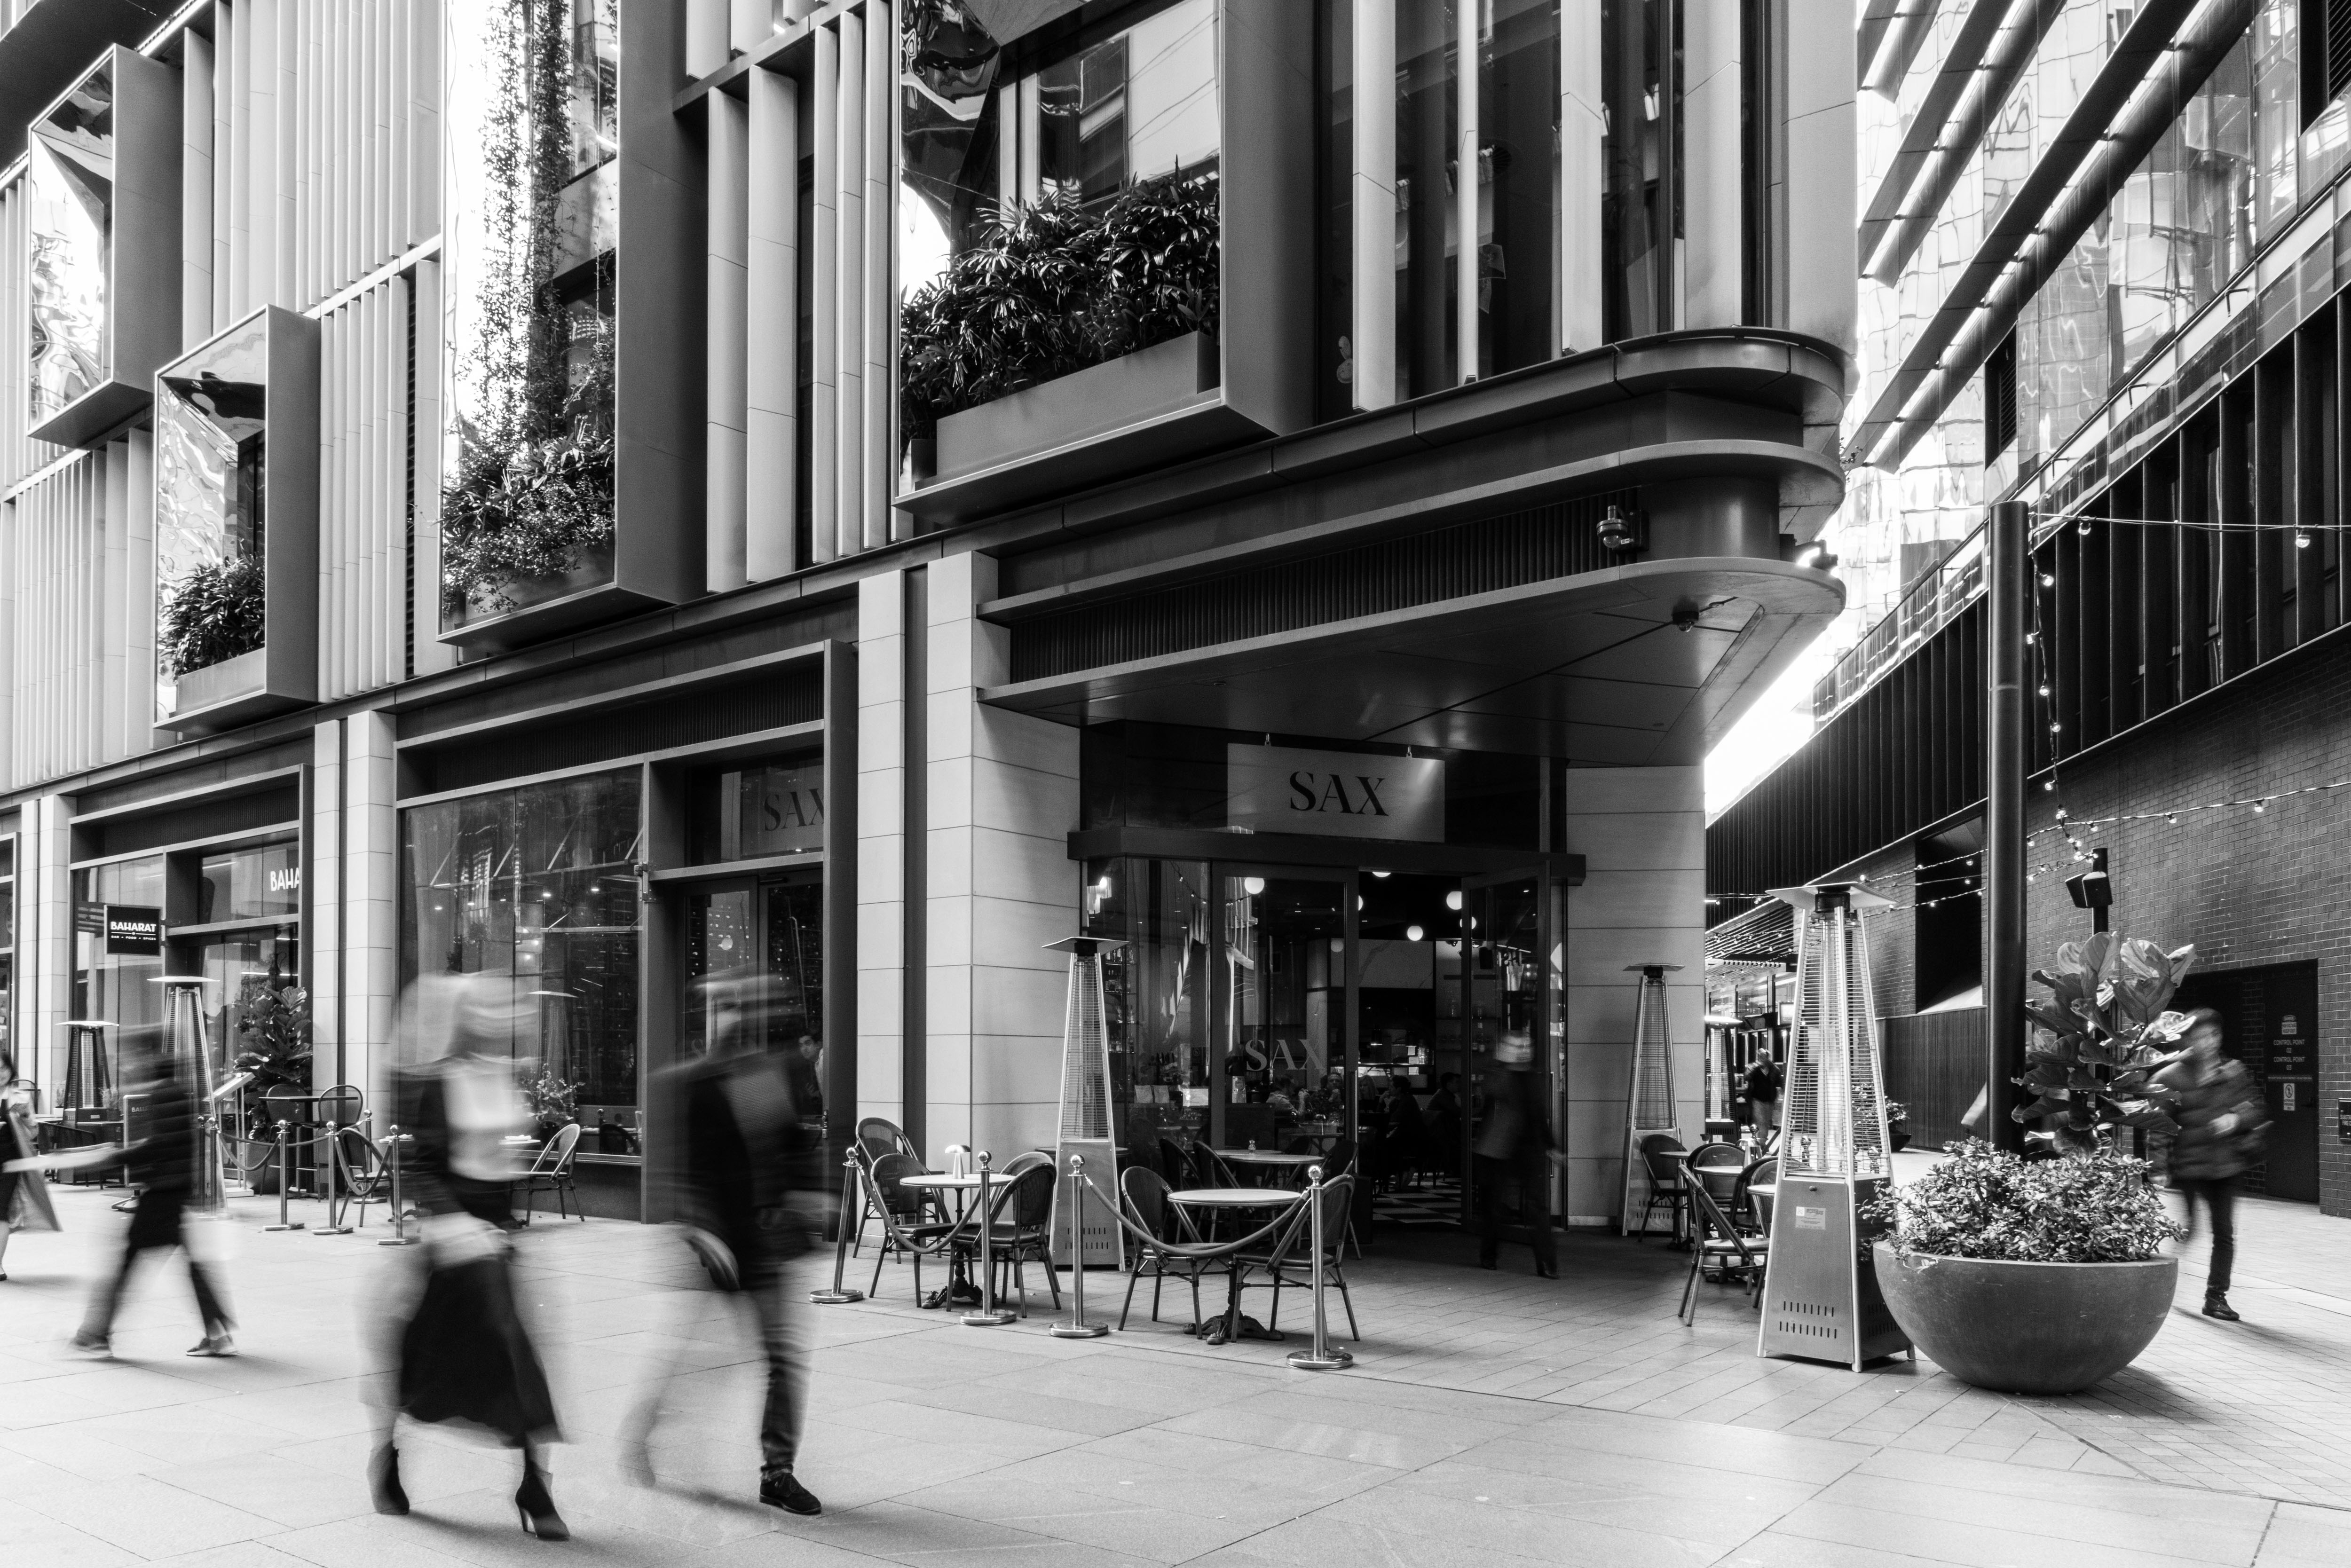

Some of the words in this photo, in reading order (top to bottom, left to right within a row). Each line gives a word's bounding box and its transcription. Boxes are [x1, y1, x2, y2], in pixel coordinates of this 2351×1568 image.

[765, 788, 824, 831] SAX
[1290, 771, 1389, 816] SAX
[270, 867, 300, 891] BAHA
[110, 921, 157, 932] BAHARAT
[1246, 1039, 1324, 1072] SAX
